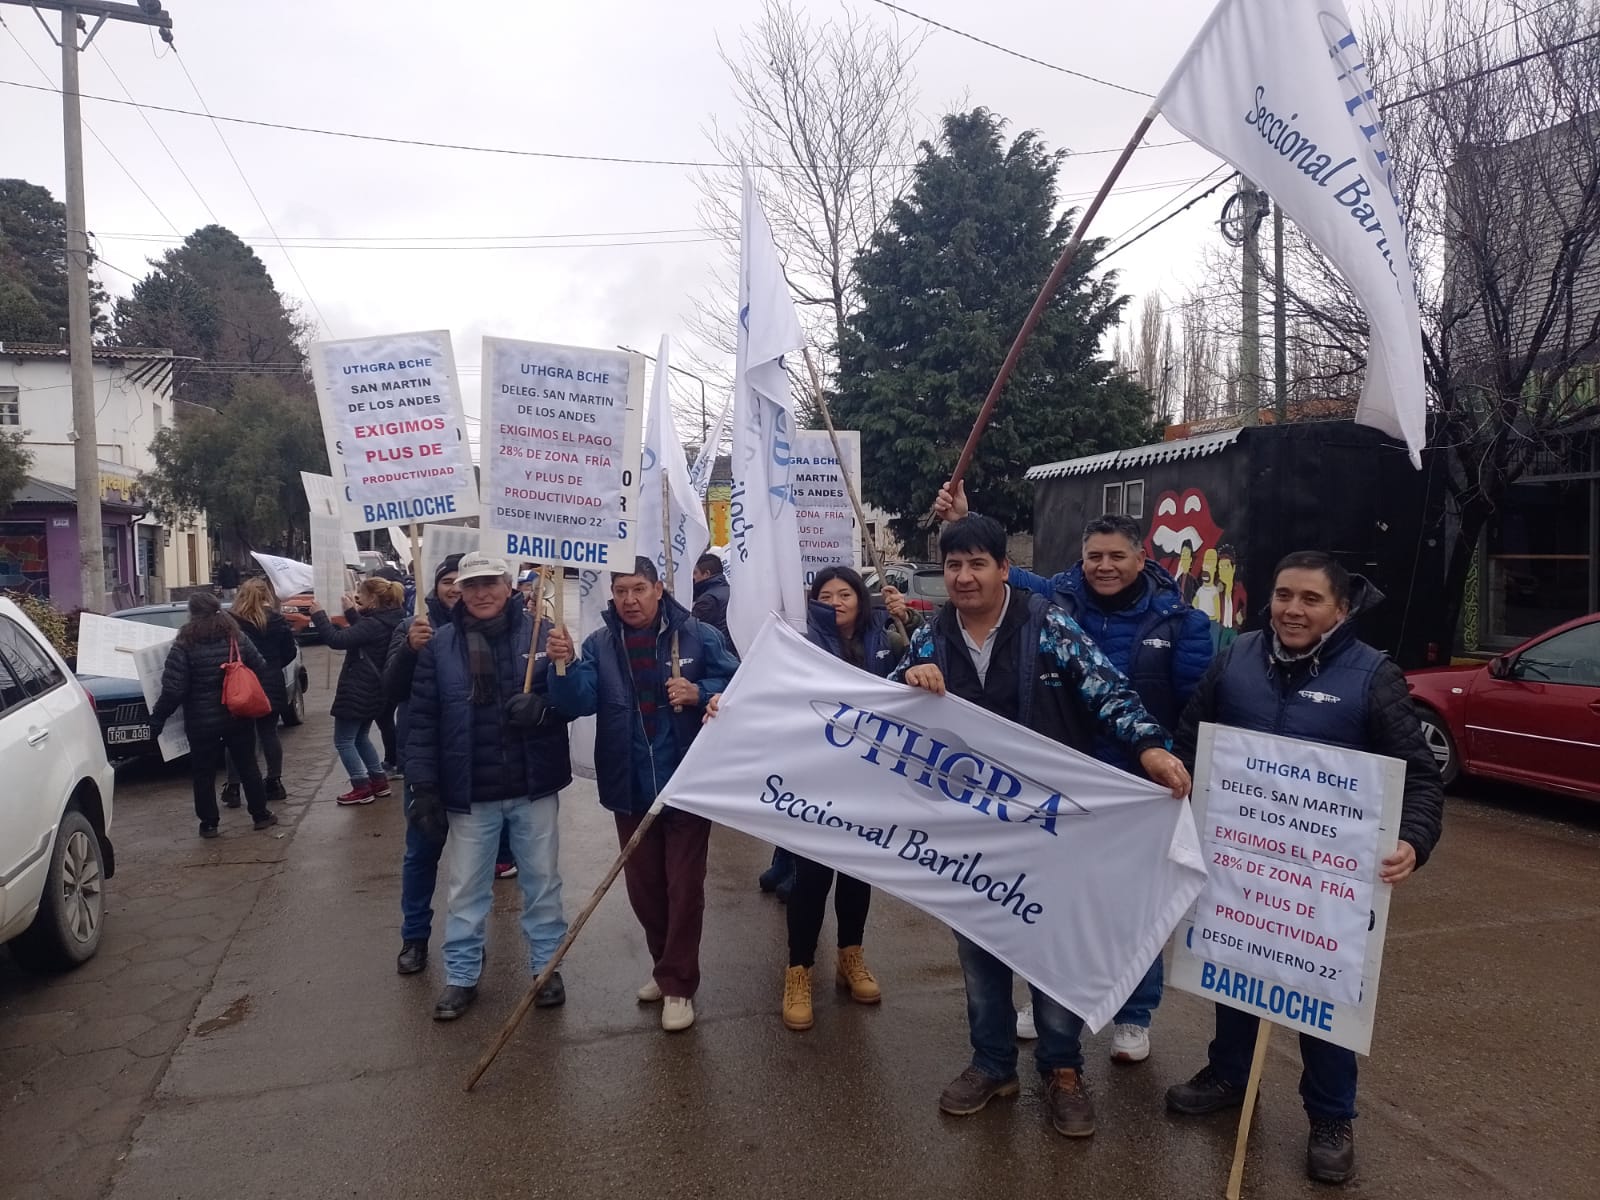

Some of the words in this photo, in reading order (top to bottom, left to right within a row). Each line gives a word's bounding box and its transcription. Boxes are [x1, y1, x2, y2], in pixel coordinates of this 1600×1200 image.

[1245, 86, 1356, 187] Seccional
[343, 362, 395, 374] UTHGRA
[400, 359, 432, 370] BCHE
[521, 364, 573, 379] UTHGRA
[578, 371, 609, 384] BCHE
[352, 384, 377, 394] SAN
[382, 378, 431, 391] MARTIN
[502, 384, 539, 398] DELEG.
[543, 389, 565, 400] SAN
[569, 392, 613, 406] MARTIN
[349, 403, 365, 412] DE
[370, 400, 394, 410] LOS
[399, 395, 440, 407] ANDES
[518, 405, 532, 414] DE
[536, 408, 555, 418] LOS
[559, 411, 596, 423] ANDES
[354, 418, 445, 438] EXIGIMOS
[500, 424, 558, 440] EXIGIMOS
[562, 432, 574, 442] EL
[578, 434, 612, 446] PAGO
[366, 446, 413, 462] PLUS
[420, 443, 442, 457] DE
[499, 445, 522, 457] 28%
[527, 449, 541, 459] DE
[545, 451, 578, 463] ZONA
[586, 454, 611, 467] FRÍA
[363, 467, 454, 484] PRODUCTIVIDAD
[525, 470, 532, 480] Y
[535, 472, 564, 484] PLUS
[568, 476, 582, 485] DE
[796, 474, 838, 482] MARTIN
[505, 487, 602, 507] PRODUCTIVIDAD
[363, 495, 456, 522] BARILOCHE
[497, 507, 530, 519] DESDE
[534, 512, 587, 526] INVIERNO
[507, 534, 608, 564] BARILOCHE
[824, 702, 1061, 836] UTHGRA
[1246, 757, 1311, 782] UTHGRA
[1317, 772, 1358, 792] BCHE
[1222, 779, 1267, 799] DELEG.
[1272, 790, 1299, 806] SAN
[1302, 798, 1363, 820] MARTIN
[1240, 806, 1256, 819] DE
[1261, 810, 1285, 826] LOS
[1289, 818, 1337, 838] ANDES
[760, 774, 897, 849] Seccional
[898, 829, 1043, 924] Bariloche
[1216, 826, 1286, 854] EXIGIMOS
[1292, 845, 1308, 860] EL
[1312, 850, 1358, 872] PAGO
[1213, 852, 1242, 870] 28%
[1247, 860, 1264, 877] DE
[1269, 866, 1312, 889] ZONA
[1321, 878, 1355, 901] FRÍA
[1243, 888, 1252, 900] Y
[1256, 891, 1290, 912] PLUS
[1296, 902, 1316, 919] DE
[1216, 904, 1338, 952] PRODUCTIVIDAD
[1202, 928, 1244, 950] DESDE
[1248, 942, 1314, 974] INVIERNO
[1201, 962, 1334, 1032] BARILOCHE
